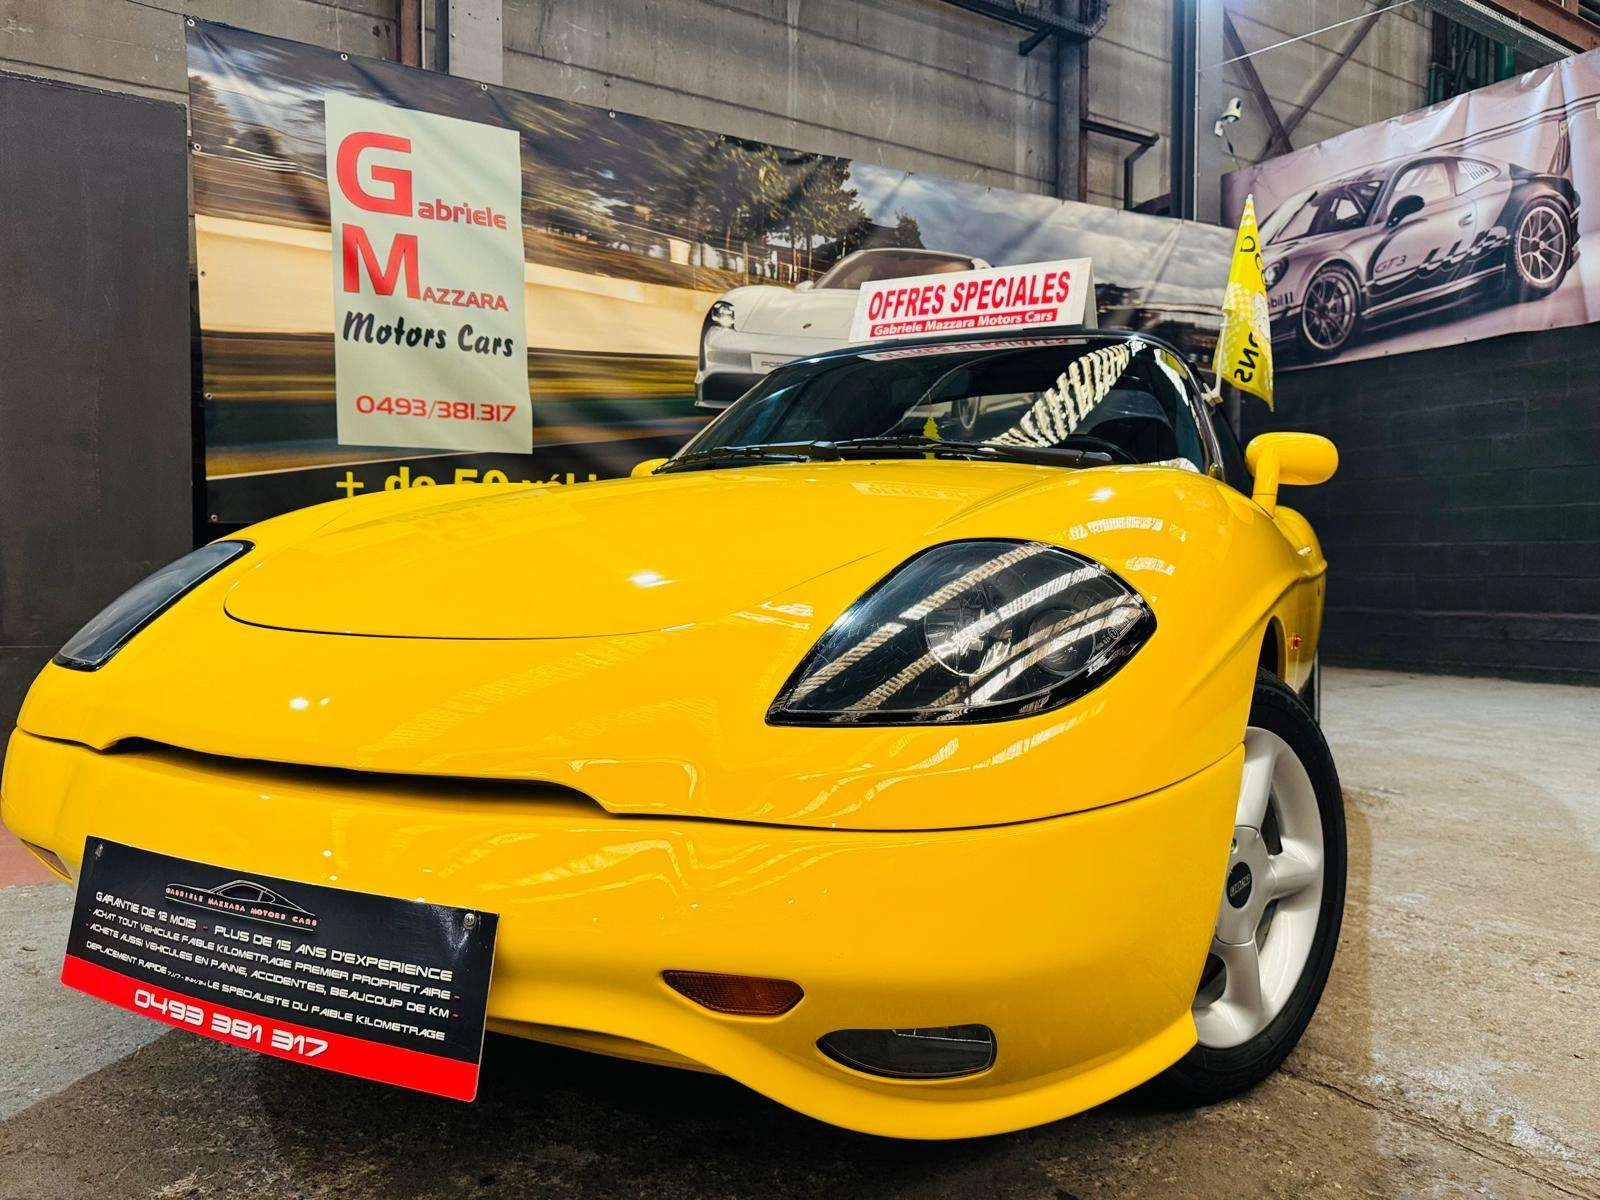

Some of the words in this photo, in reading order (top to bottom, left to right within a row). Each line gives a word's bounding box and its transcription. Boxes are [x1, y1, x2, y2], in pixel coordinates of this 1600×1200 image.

[868, 283, 946, 320] OFFRES
[951, 271, 1071, 312] SPECIALES
[873, 321, 922, 336] Gabriele
[924, 317, 975, 332] Mazzara
[977, 314, 1022, 327] Motors
[1024, 311, 1053, 323] Cars
[343, 310, 447, 349] Motors
[457, 323, 513, 358] Cars
[356, 395, 517, 423] 0493/381.317
[95, 891, 140, 914] GARANTIE
[141, 905, 156, 918] DE
[157, 910, 168, 921] 12
[169, 913, 197, 930] MOIS
[214, 925, 250, 942] PLUS
[252, 933, 273, 947] DE
[276, 939, 292, 952] 15
[295, 944, 327, 959] ANS
[331, 949, 453, 982] D'EXPERIENCE
[250, 907, 286, 920] MOTORS
[291, 915, 318, 927] CARS
[89, 922, 119, 939] ACHETE
[120, 932, 144, 947] AUSSI
[145, 940, 193, 962] VEHICULES
[194, 954, 209, 967] EN
[210, 959, 248, 977] PANNE,
[250, 970, 327, 995] ACCIDENTES,
[330, 986, 403, 1008] BEAUCOUP
[406, 1001, 426, 1013] DE
[428, 1005, 450, 1018] KM
[92, 908, 117, 921] ACHAT
[118, 915, 139, 929] TOUT
[140, 922, 180, 941] VEHICULE
[181, 935, 215, 951] FAIBLE
[216, 943, 292, 968] KILOMETRAGE
[294, 961, 349, 981] PREMIER
[352, 973, 451, 1000] PROPRIETAIRE
[86, 940, 138, 964] DEPLACEMENT
[138, 958, 168, 975] RAPIDE
[207, 980, 220, 990] LE
[221, 983, 290, 1008] SPECIALISTE
[292, 1000, 309, 1012] DU
[311, 1005, 354, 1022] FAIBLE
[356, 1014, 446, 1041] KILOMETRAGE
[134, 988, 205, 1026] 0493
[210, 1012, 263, 1044] 381
[271, 1028, 329, 1057] 317
